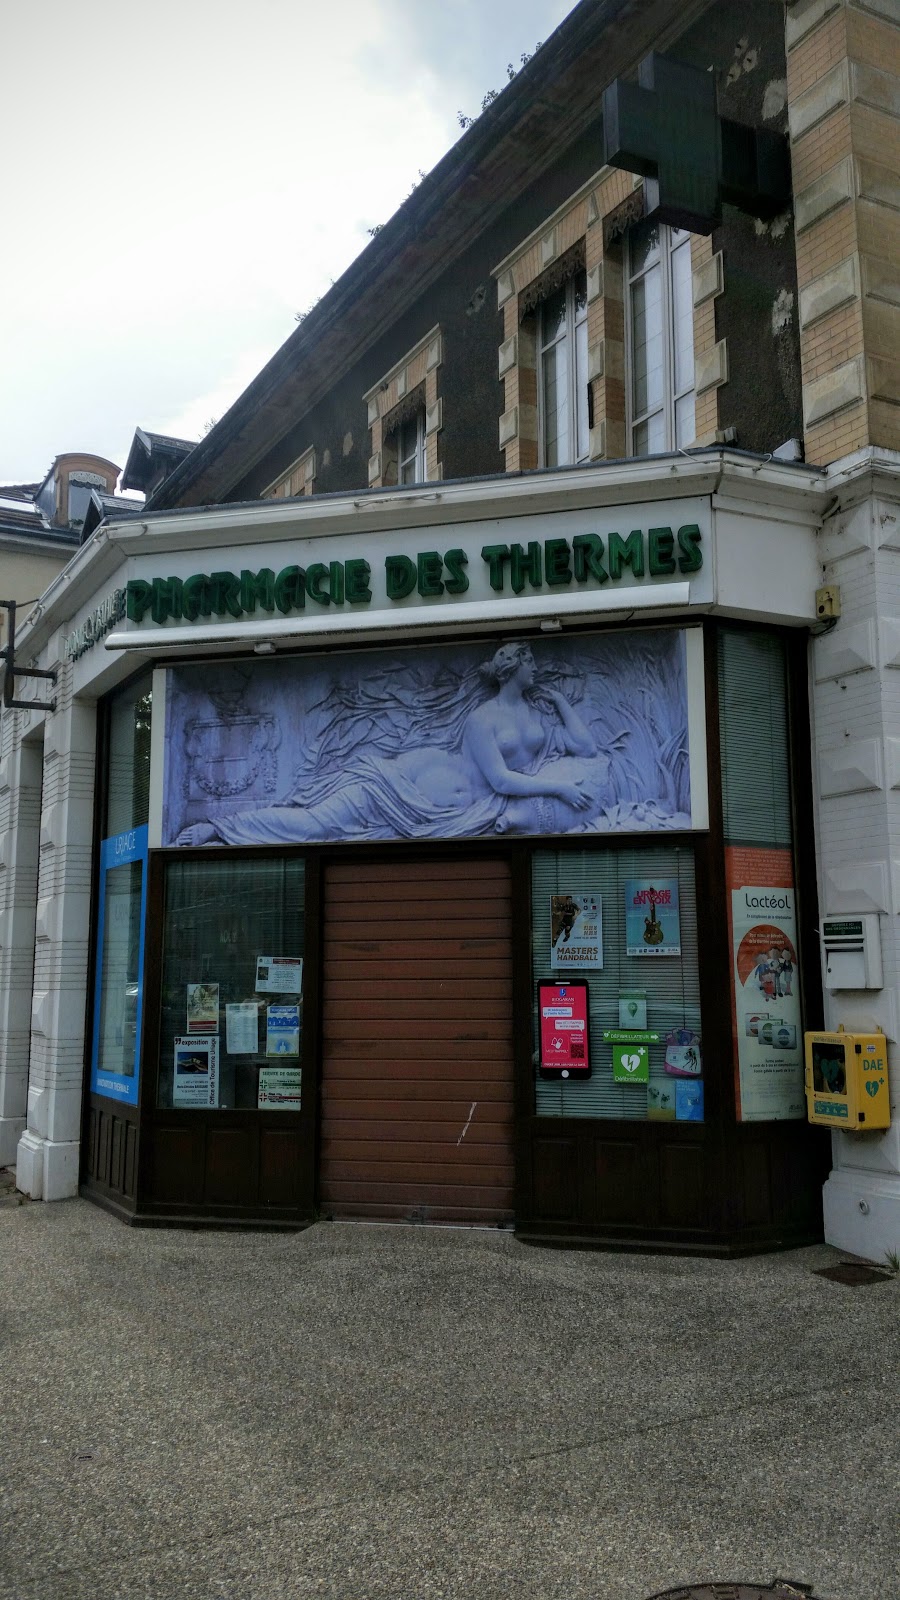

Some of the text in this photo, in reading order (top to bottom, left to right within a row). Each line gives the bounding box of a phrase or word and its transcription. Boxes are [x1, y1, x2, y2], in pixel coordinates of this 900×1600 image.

[127, 524, 703, 625] PHARMACIE DES THERMES
[557, 947, 599, 955] MASTERS
[182, 1038, 208, 1046] exposition
[863, 1059, 884, 1070] DAE
